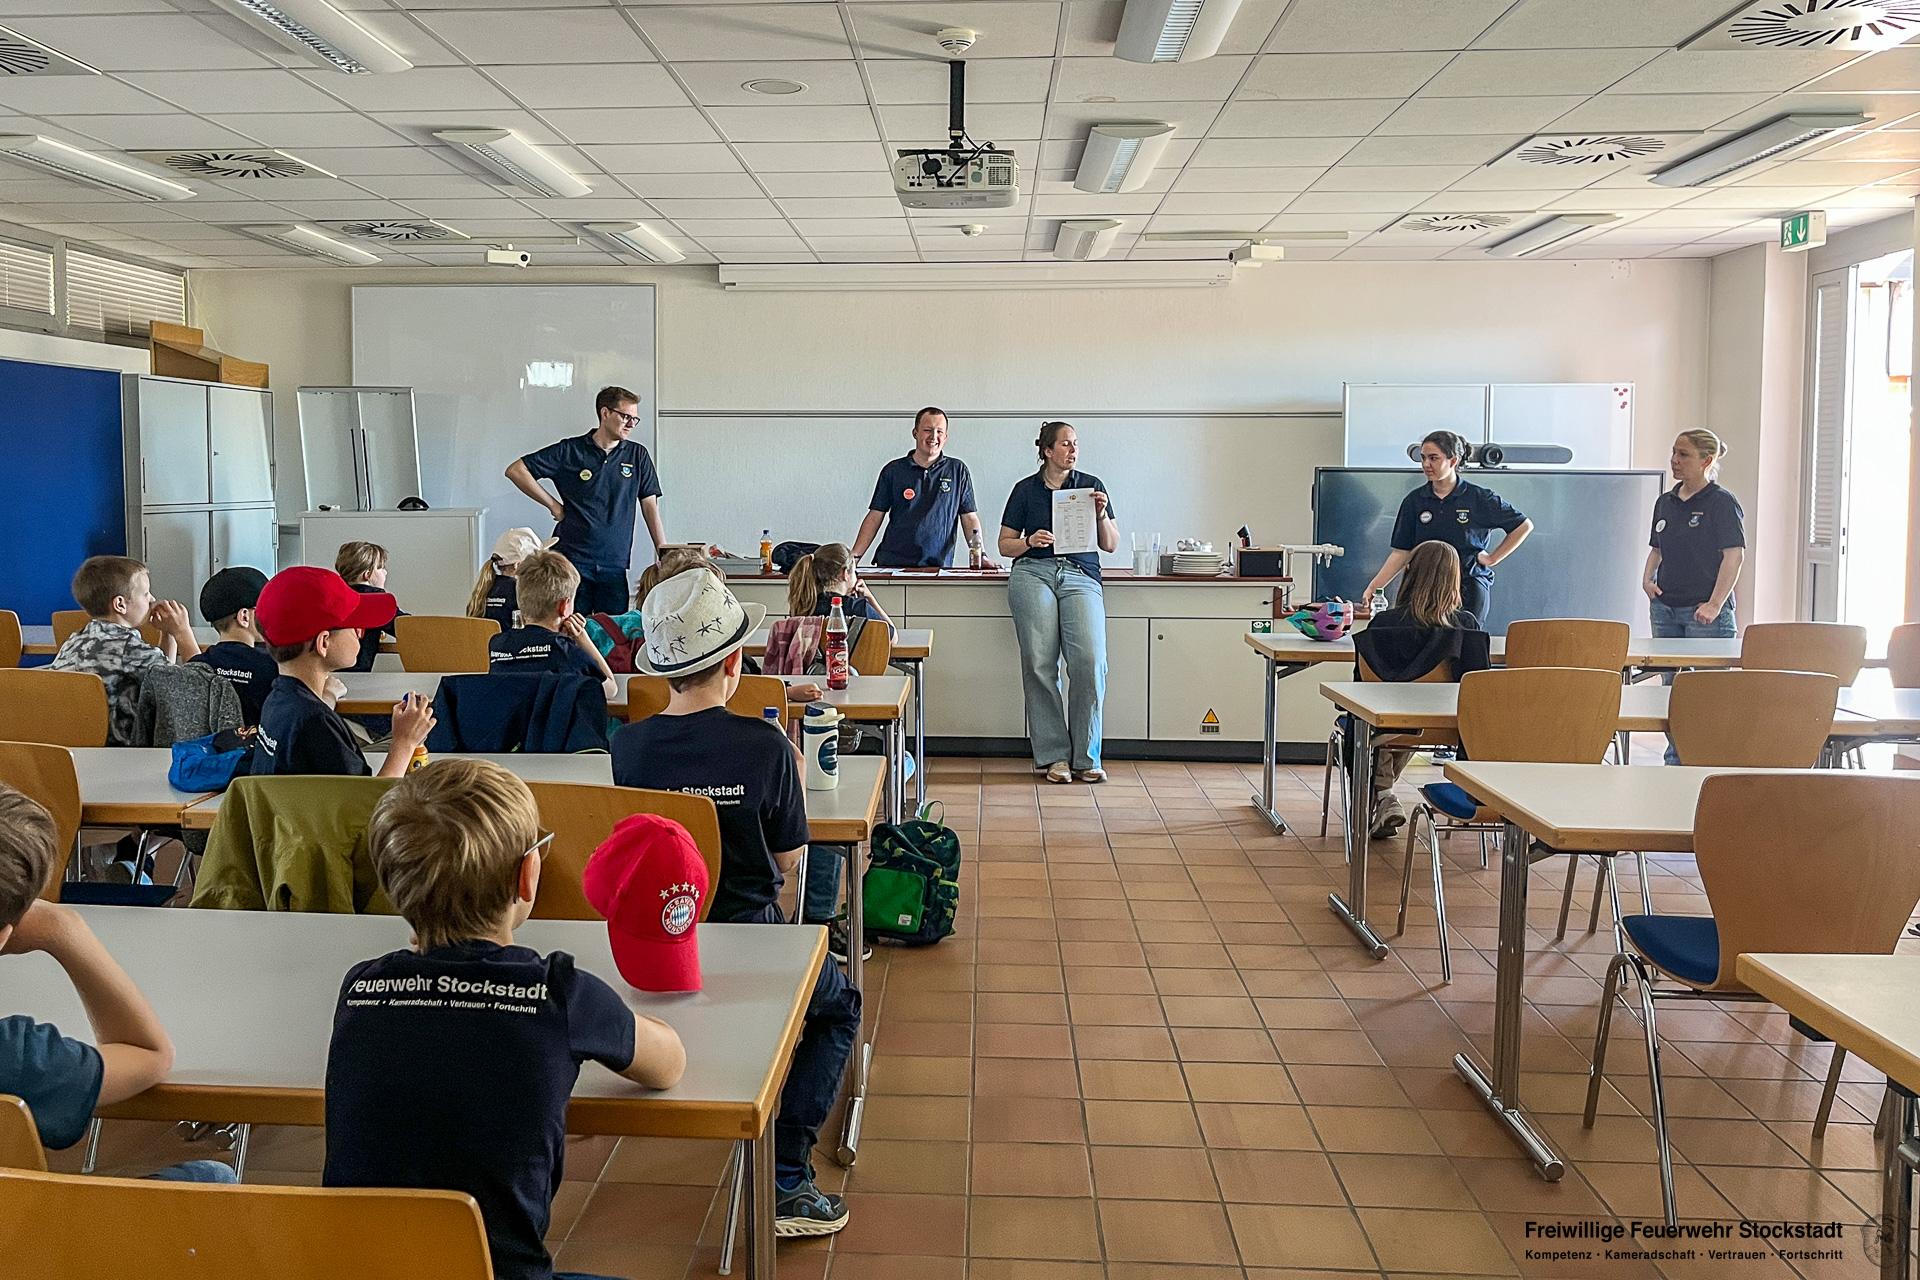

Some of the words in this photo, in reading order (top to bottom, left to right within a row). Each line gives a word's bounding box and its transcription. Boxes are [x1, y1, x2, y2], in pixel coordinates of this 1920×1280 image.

[682, 784, 744, 796] Stockstadt
[437, 975, 547, 1000] Stockstadt
[389, 999, 442, 1007] Kameradschaft
[450, 999, 486, 1009] Vertrauen
[494, 1002, 536, 1014] Fortschritt
